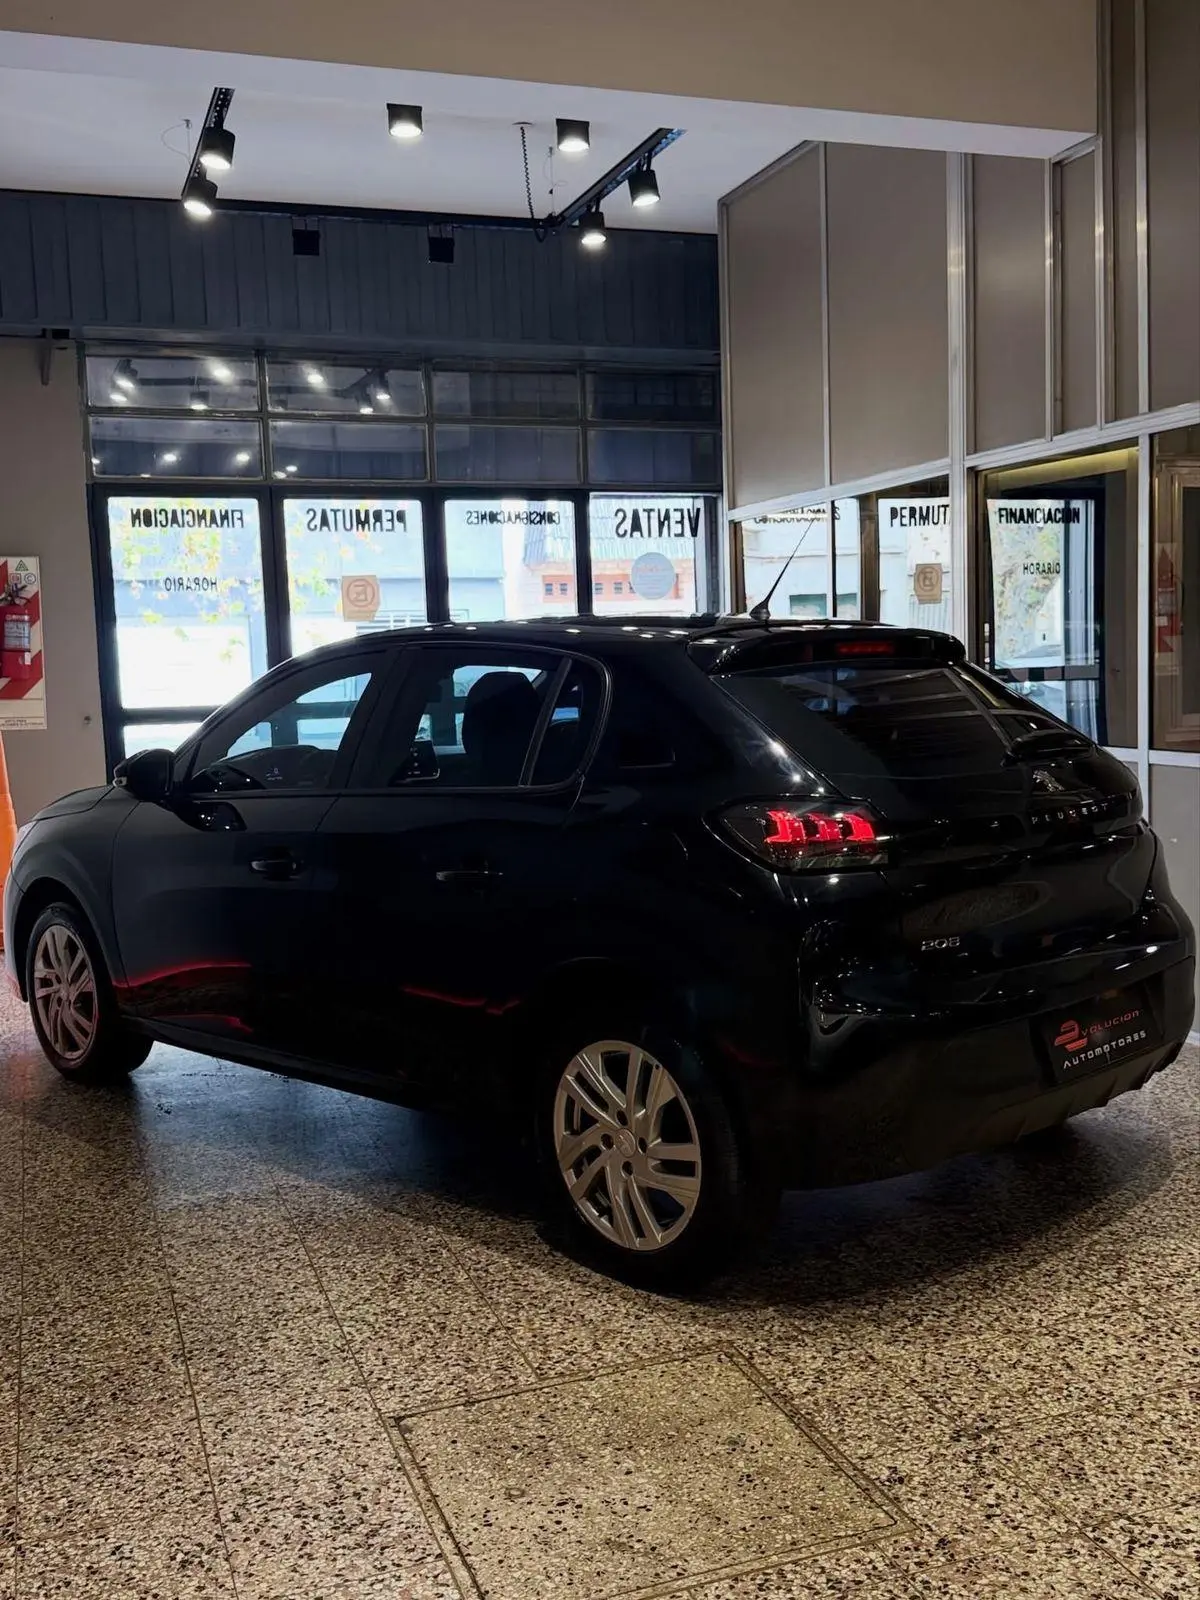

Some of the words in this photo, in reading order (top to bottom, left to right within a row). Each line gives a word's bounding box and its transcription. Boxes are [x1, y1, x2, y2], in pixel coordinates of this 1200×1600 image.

[889, 504, 951, 528] PERMUT
[998, 507, 1081, 525] FINANCIACION
[1022, 561, 1061, 575] HORARIO
[921, 937, 960, 951] 208
[1063, 1030, 1147, 1070] AUTOMOTORES
